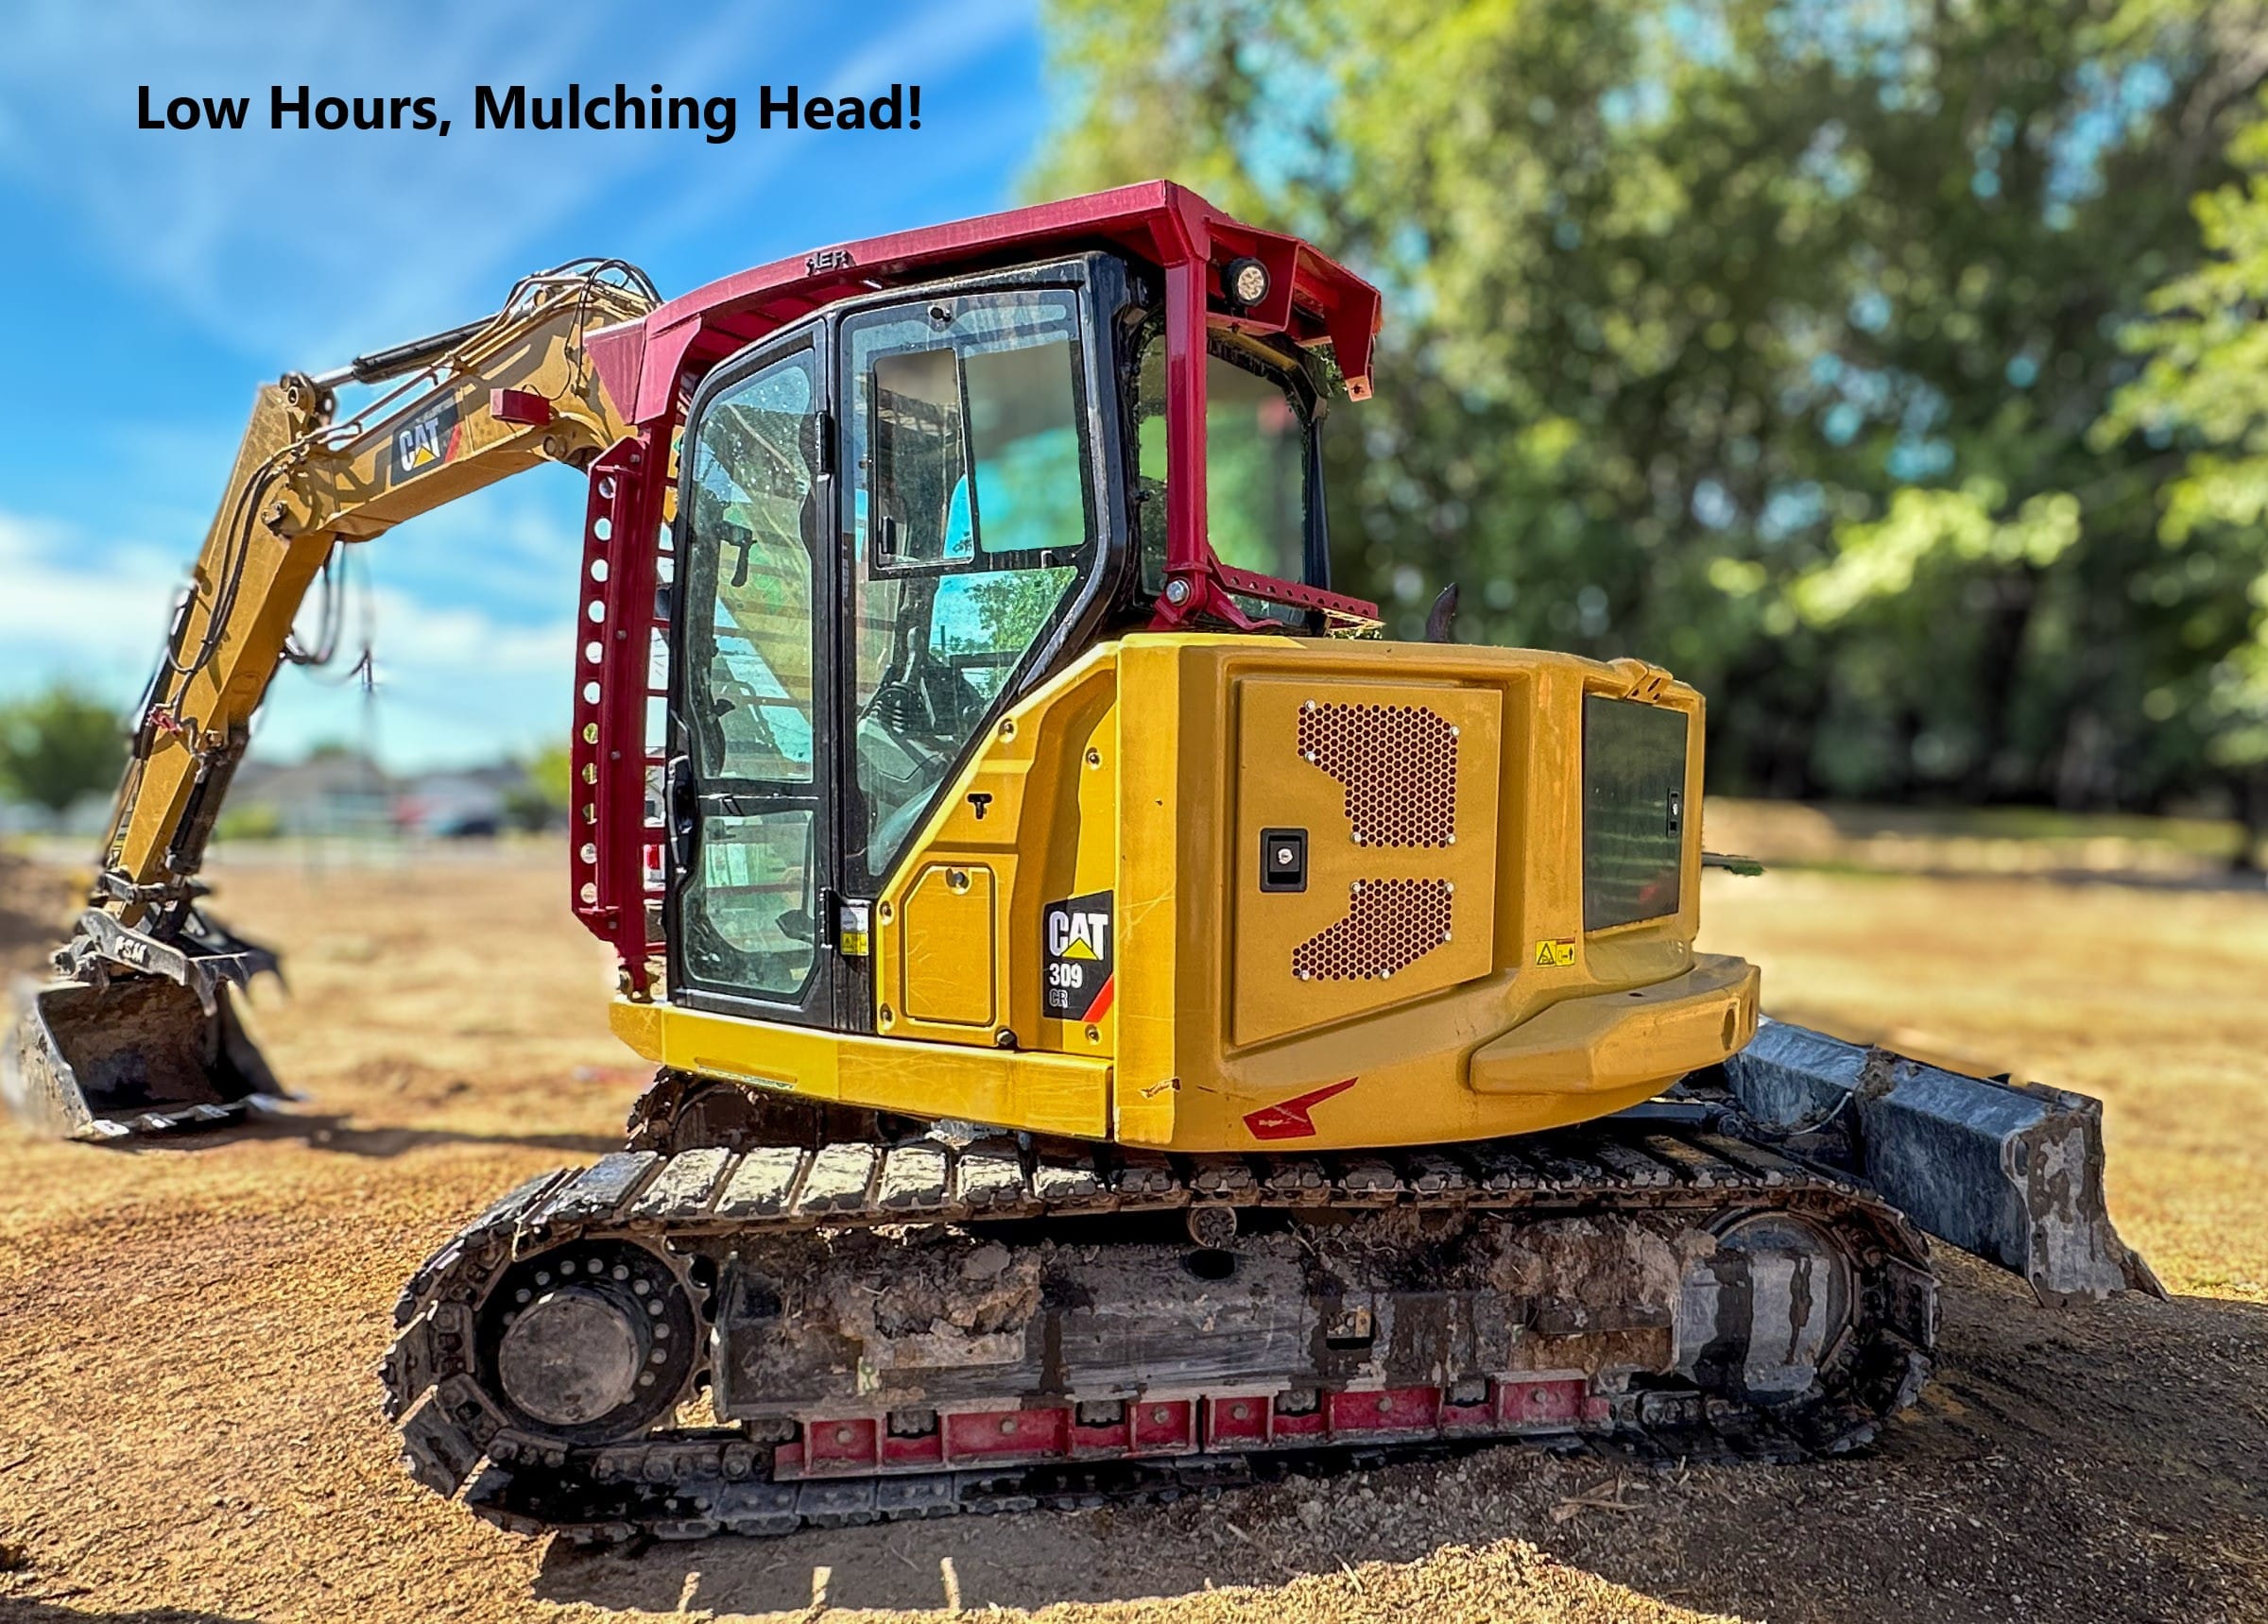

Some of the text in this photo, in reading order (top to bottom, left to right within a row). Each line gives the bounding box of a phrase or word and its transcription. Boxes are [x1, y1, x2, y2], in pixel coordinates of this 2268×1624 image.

[399, 417, 440, 471] CAT
[1049, 911, 1108, 961] CAT
[1049, 963, 1083, 988] 309
[1049, 988, 1069, 1009] CR
